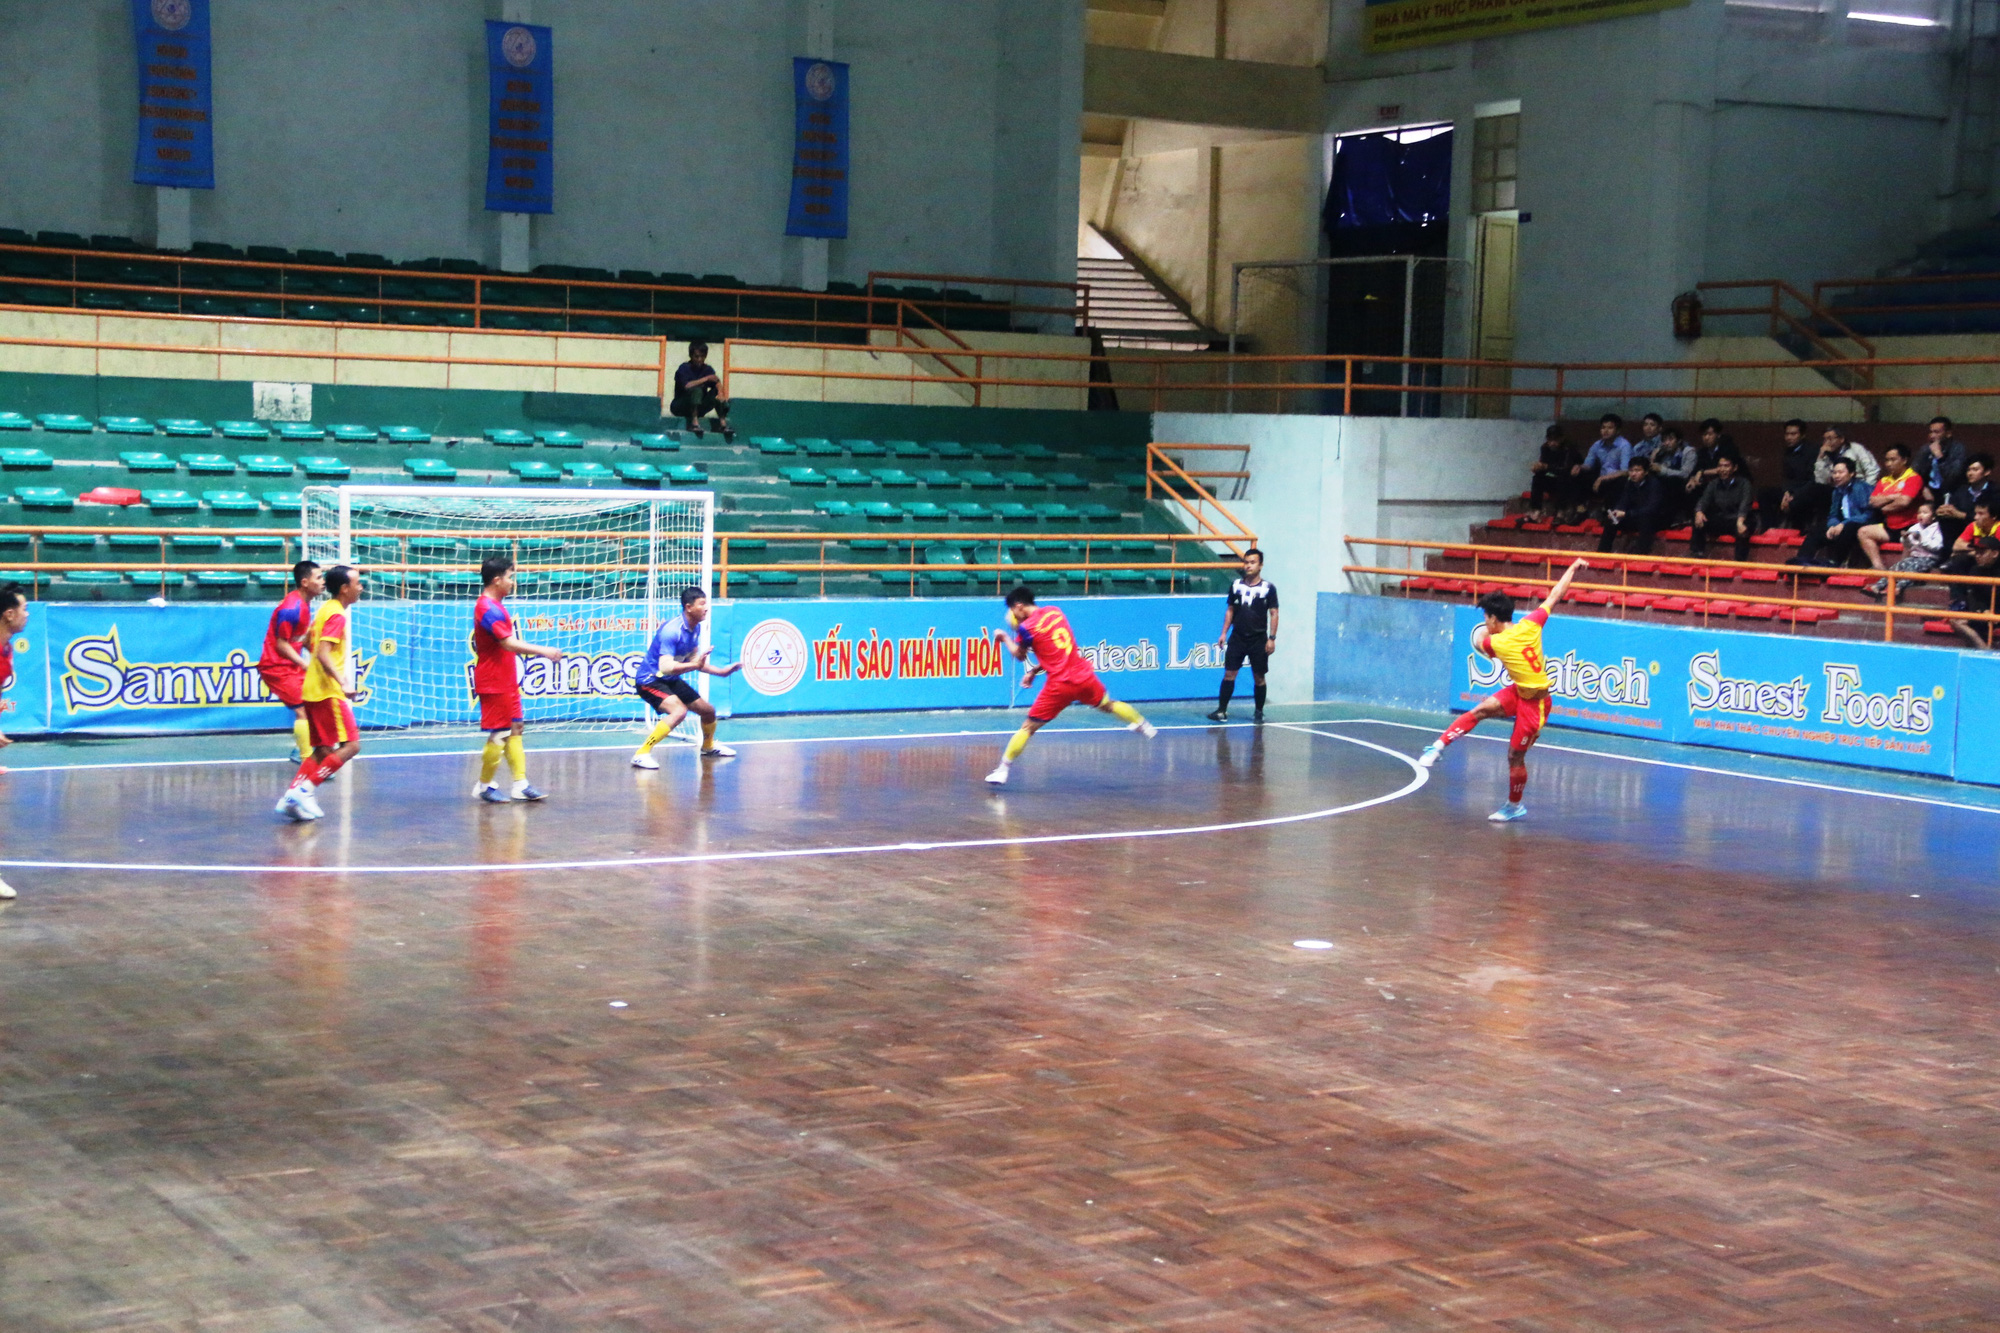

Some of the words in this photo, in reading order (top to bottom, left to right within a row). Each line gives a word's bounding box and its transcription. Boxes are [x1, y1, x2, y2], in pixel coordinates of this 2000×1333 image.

[813, 623, 851, 682] YẾN
[856, 628, 893, 681] SÀO
[899, 626, 960, 680] KHÁNH
[966, 626, 1003, 679] HÒA
[1051, 627, 1073, 656] 9
[1521, 646, 1542, 674] 8
[1688, 650, 1809, 719] Sanest
[1822, 663, 1932, 734] Foods
[1714, 720, 1735, 732] KHAI
[1737, 720, 1760, 735] THÁC
[1762, 725, 1800, 740] CHUYÊN
[1802, 730, 1836, 744] NGHIỆP
